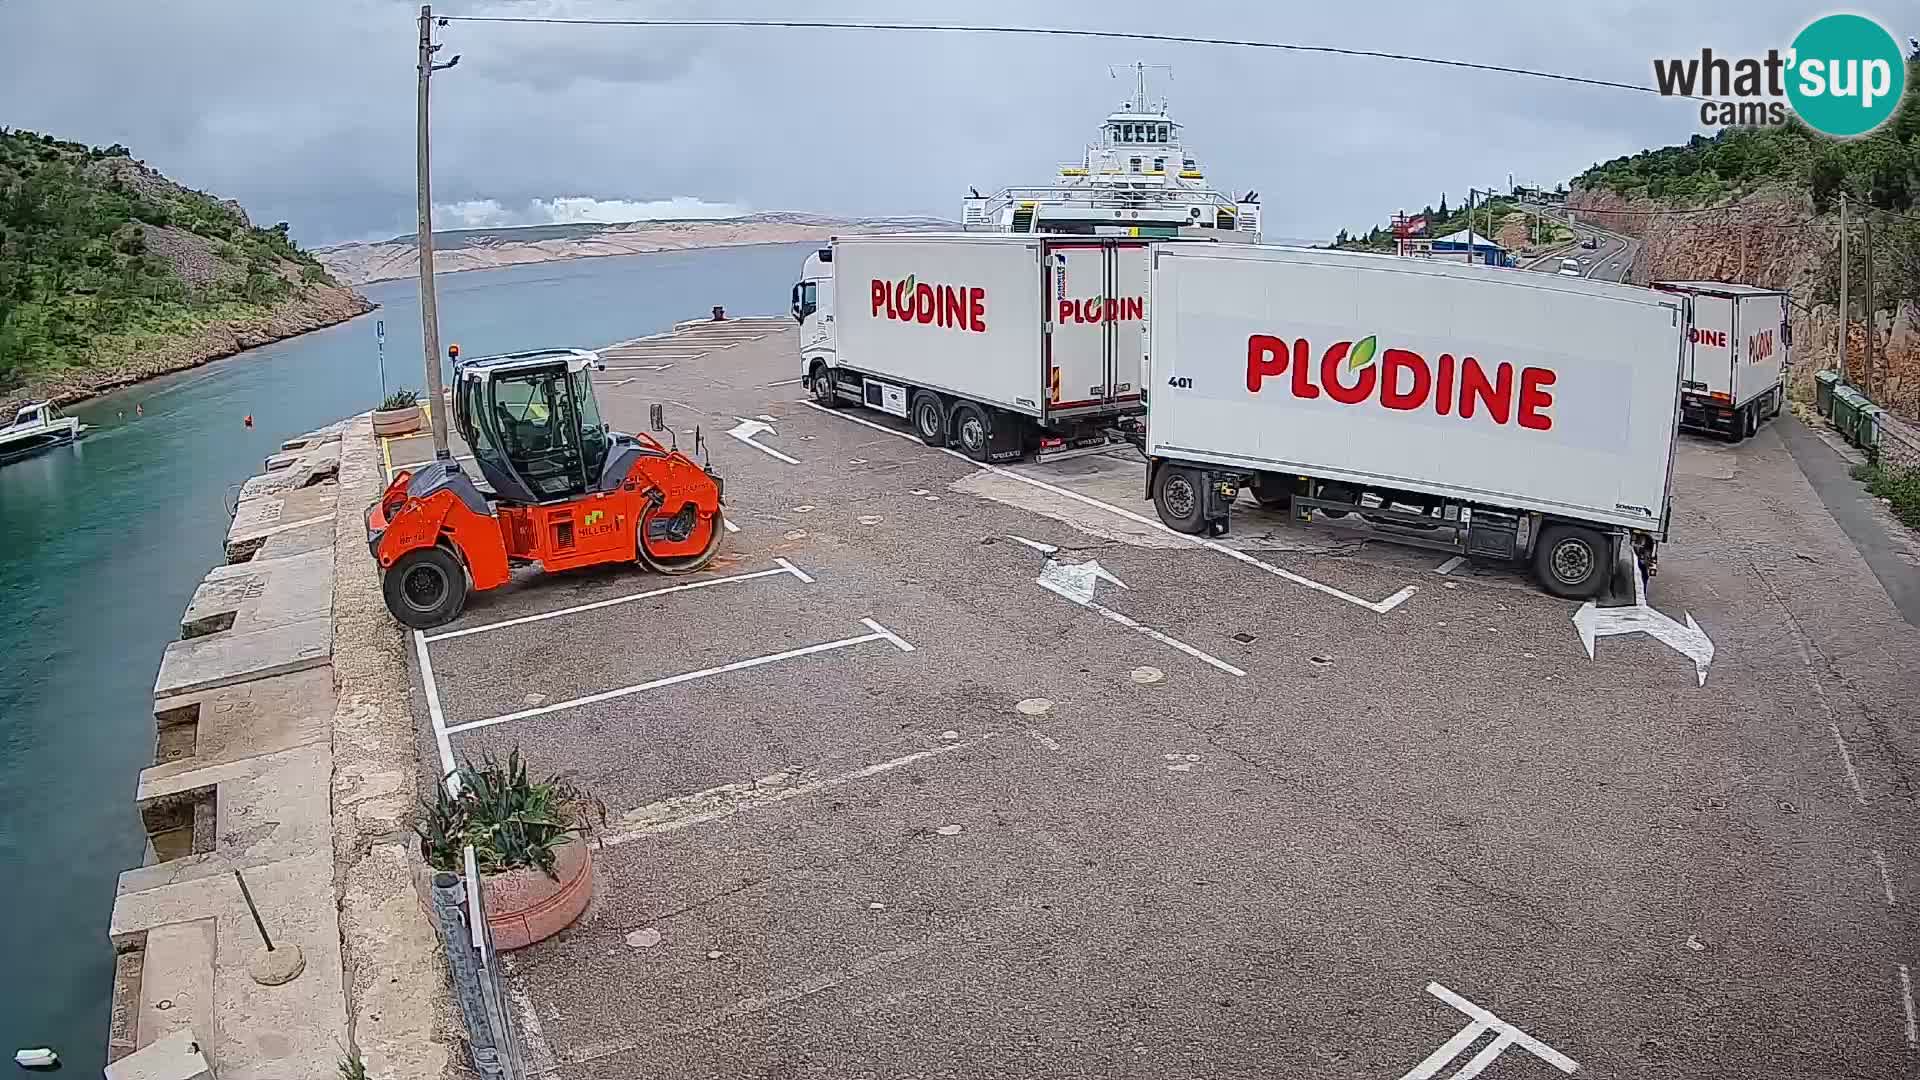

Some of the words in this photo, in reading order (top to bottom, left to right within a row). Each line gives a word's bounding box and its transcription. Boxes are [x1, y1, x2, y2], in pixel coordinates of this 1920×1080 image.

[871, 276, 986, 332] PLODINE
[1059, 295, 1143, 324] PLODIN
[1689, 328, 1726, 347] DINE
[1168, 376, 1193, 389] 401
[1246, 335, 1557, 430] PLODINE
